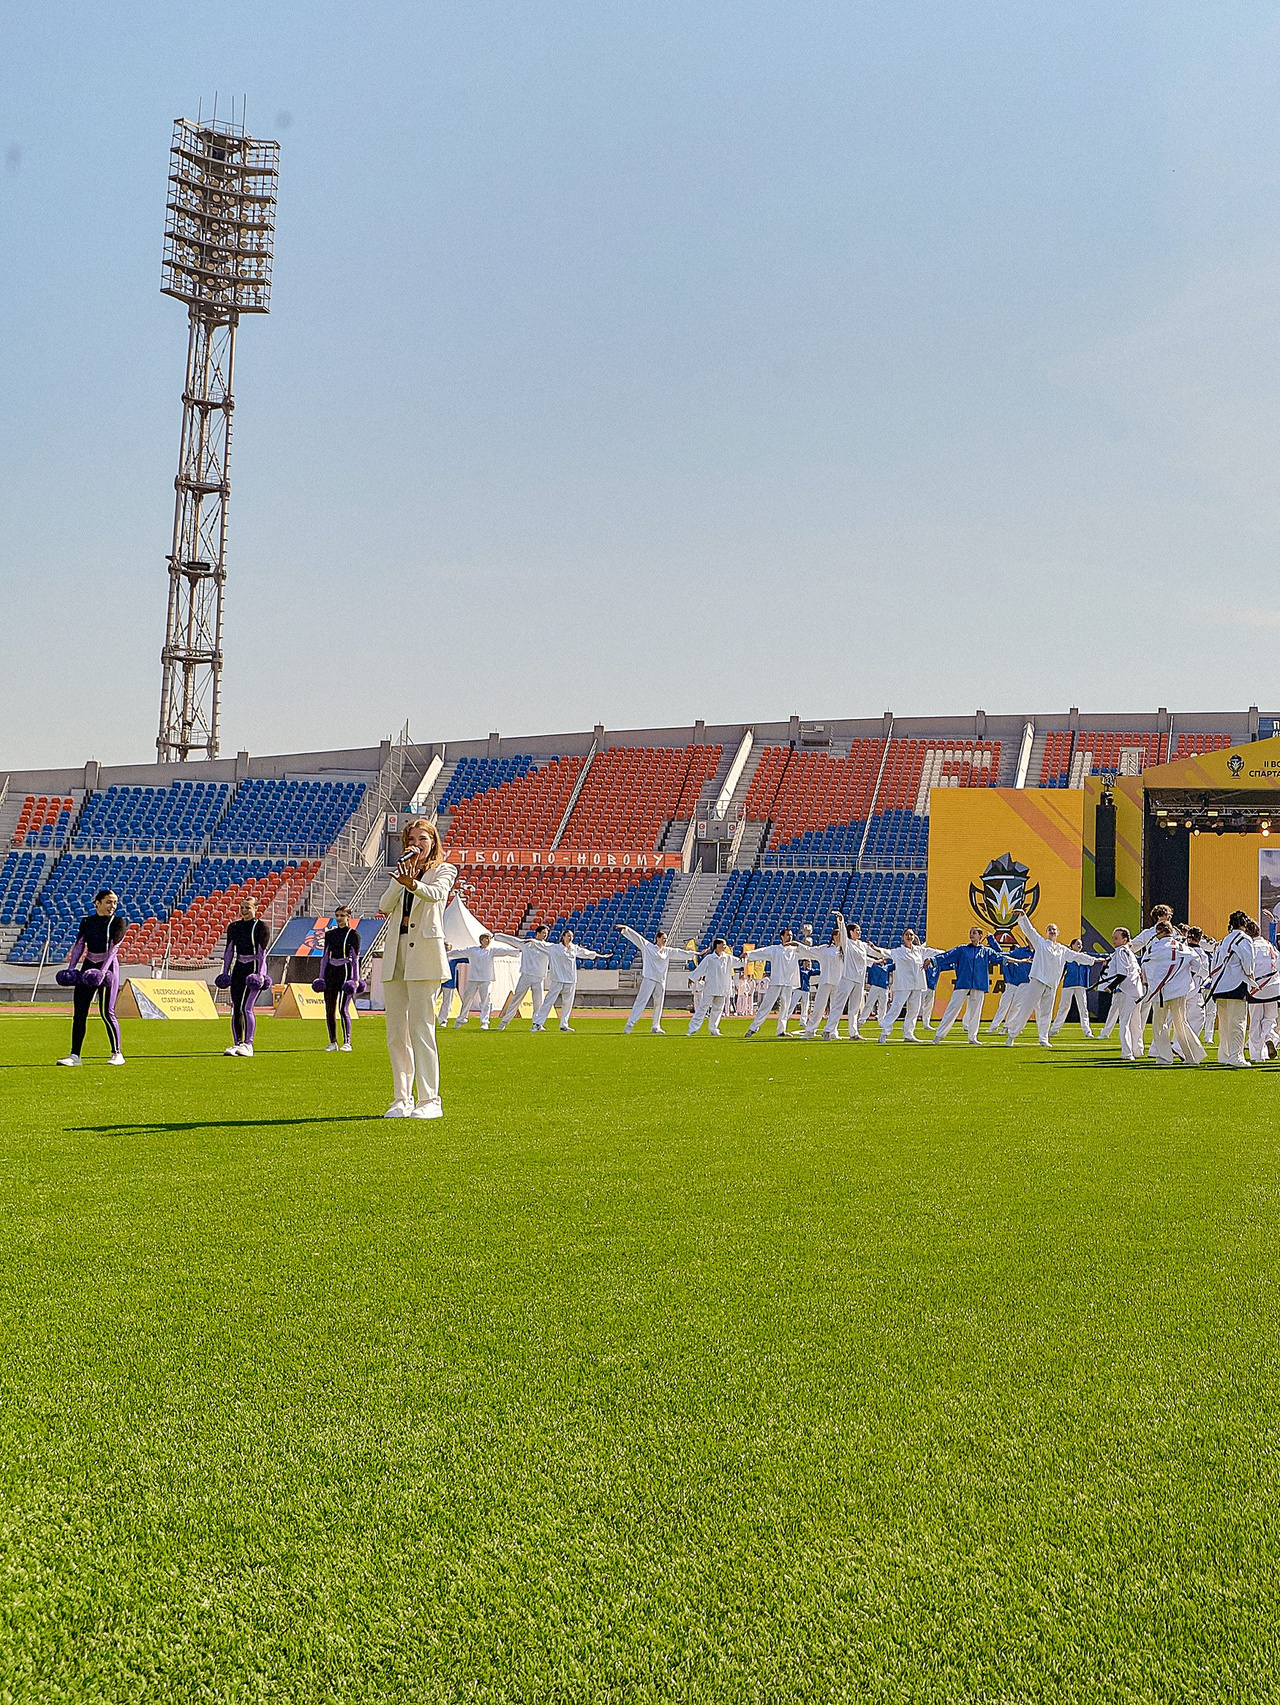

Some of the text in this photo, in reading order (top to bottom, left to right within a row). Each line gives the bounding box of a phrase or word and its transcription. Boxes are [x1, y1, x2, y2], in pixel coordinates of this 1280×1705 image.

[1263, 760, 1269, 768] II
[441, 850, 664, 866] УТБОЛ ПО-НОВОМУ
